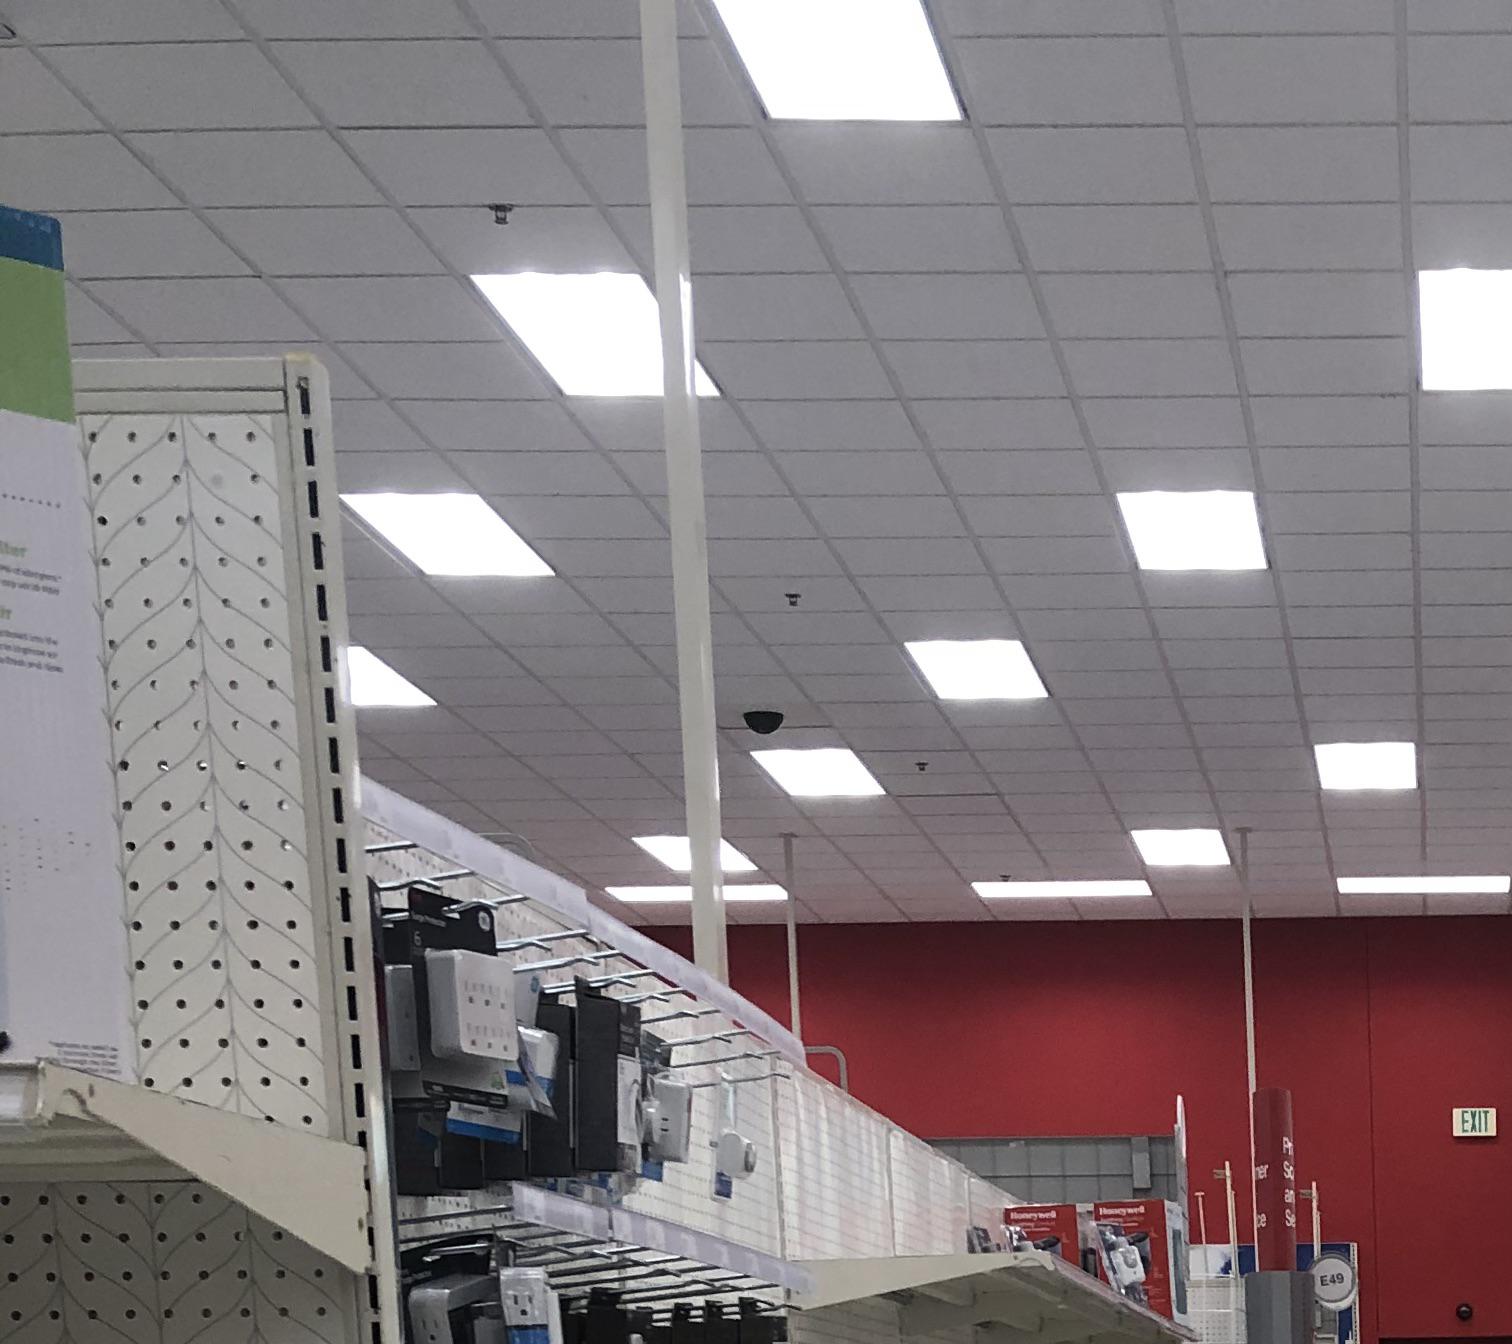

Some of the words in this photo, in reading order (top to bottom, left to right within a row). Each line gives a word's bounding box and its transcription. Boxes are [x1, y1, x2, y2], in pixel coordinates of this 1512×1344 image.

[1461, 1109, 1490, 1134] EXIT
[1010, 1210, 1057, 1221] Honeywell
[1100, 1205, 1146, 1216] Honeywell
[1319, 1272, 1345, 1287] E49
